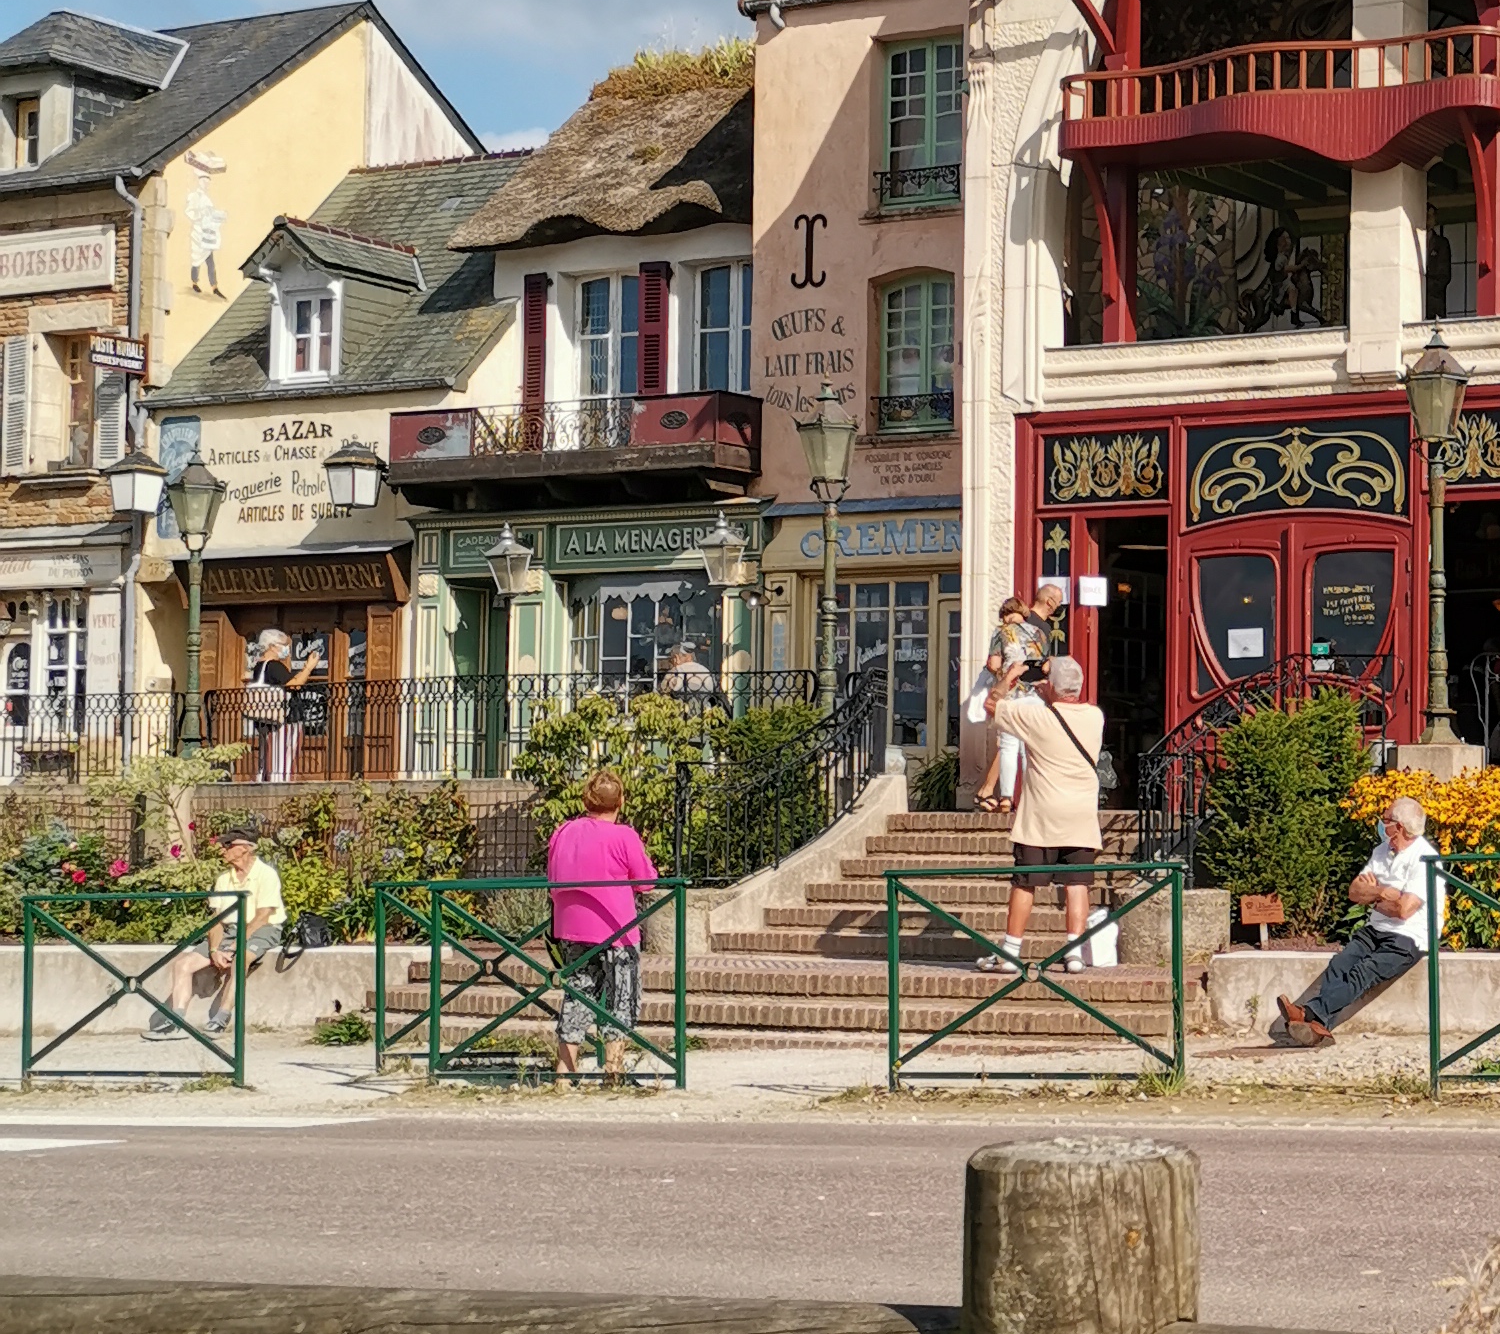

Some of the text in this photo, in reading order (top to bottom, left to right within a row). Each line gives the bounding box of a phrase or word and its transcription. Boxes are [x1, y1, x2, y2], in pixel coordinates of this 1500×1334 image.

[831, 315, 846, 337] &
[764, 348, 855, 378] LAIT FRAIS
[765, 382, 793, 412] tous
[794, 385, 816, 413] les
[262, 420, 334, 443] BAZAR
[208, 447, 260, 466] ARTICLES
[274, 445, 318, 461] CHASSE
[237, 503, 285, 524] ARTICLES
[291, 503, 305, 522] DE
[564, 529, 581, 555] A
[583, 529, 608, 555] LA
[284, 562, 387, 593] MODERNE
